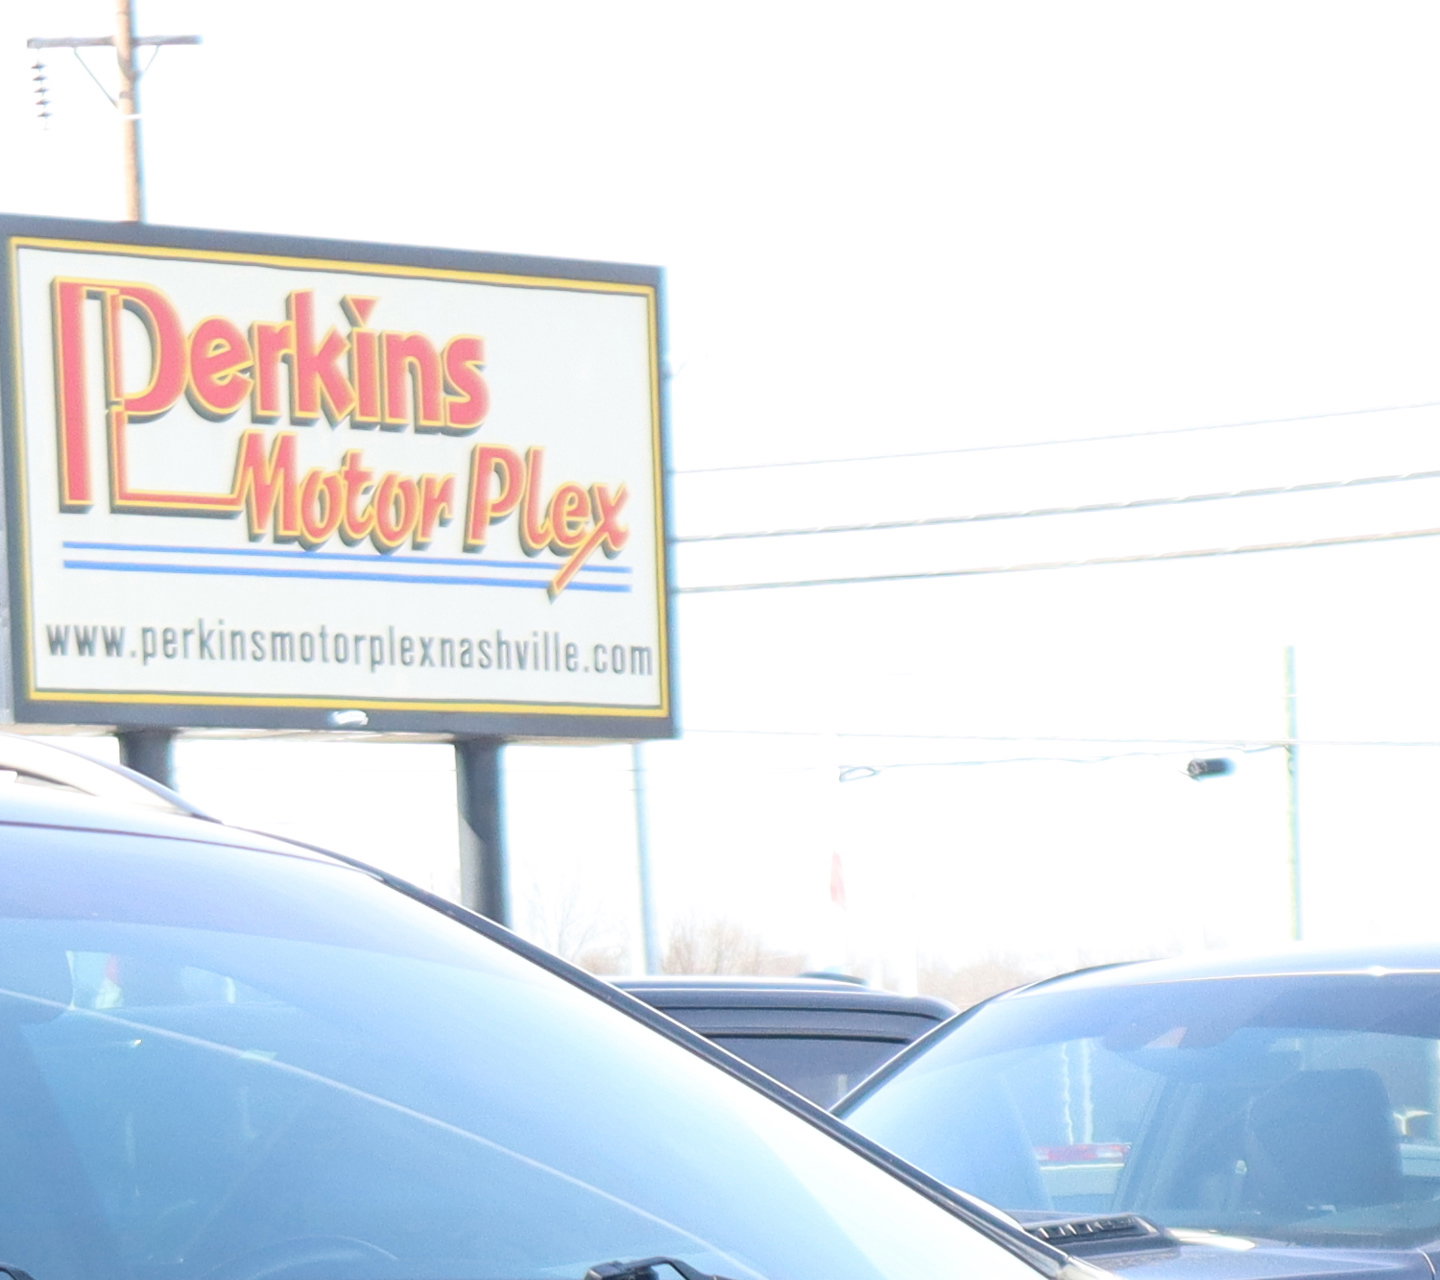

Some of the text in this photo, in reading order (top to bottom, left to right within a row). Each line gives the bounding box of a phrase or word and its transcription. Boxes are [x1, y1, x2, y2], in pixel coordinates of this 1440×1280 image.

[51, 275, 492, 514] Perkins
[230, 428, 631, 602] Motor Plex
[45, 618, 654, 677] www.perkinsmotorplexnashville.com
